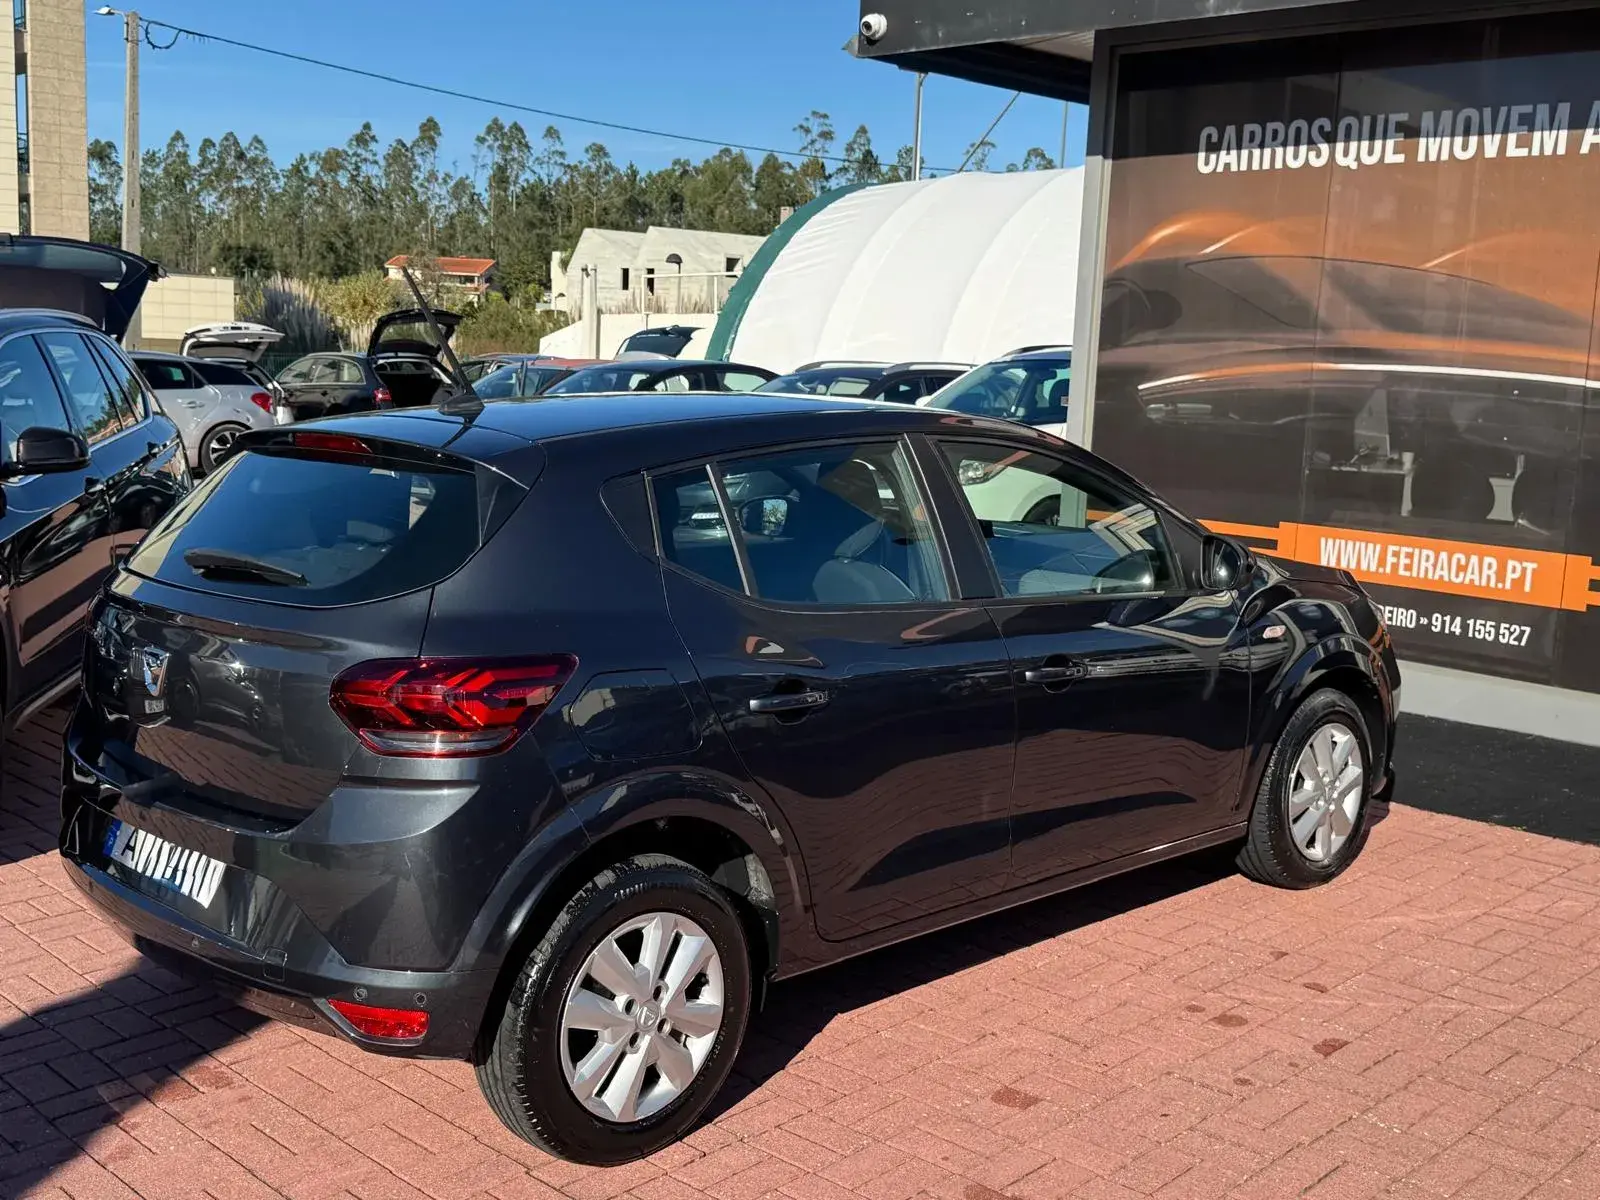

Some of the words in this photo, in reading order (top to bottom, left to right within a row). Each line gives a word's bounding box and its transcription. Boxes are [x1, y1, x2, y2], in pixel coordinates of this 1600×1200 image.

[1196, 117, 1332, 174] CARROS
[1334, 111, 1409, 170] QUE
[1416, 102, 1571, 163] MOVEM
[1319, 536, 1538, 593] WWW.FEIRACAR.PT
[1378, 604, 1417, 629] EIRO
[1431, 612, 1462, 637] 914
[1466, 618, 1496, 642] 155
[1499, 622, 1532, 647] 527
